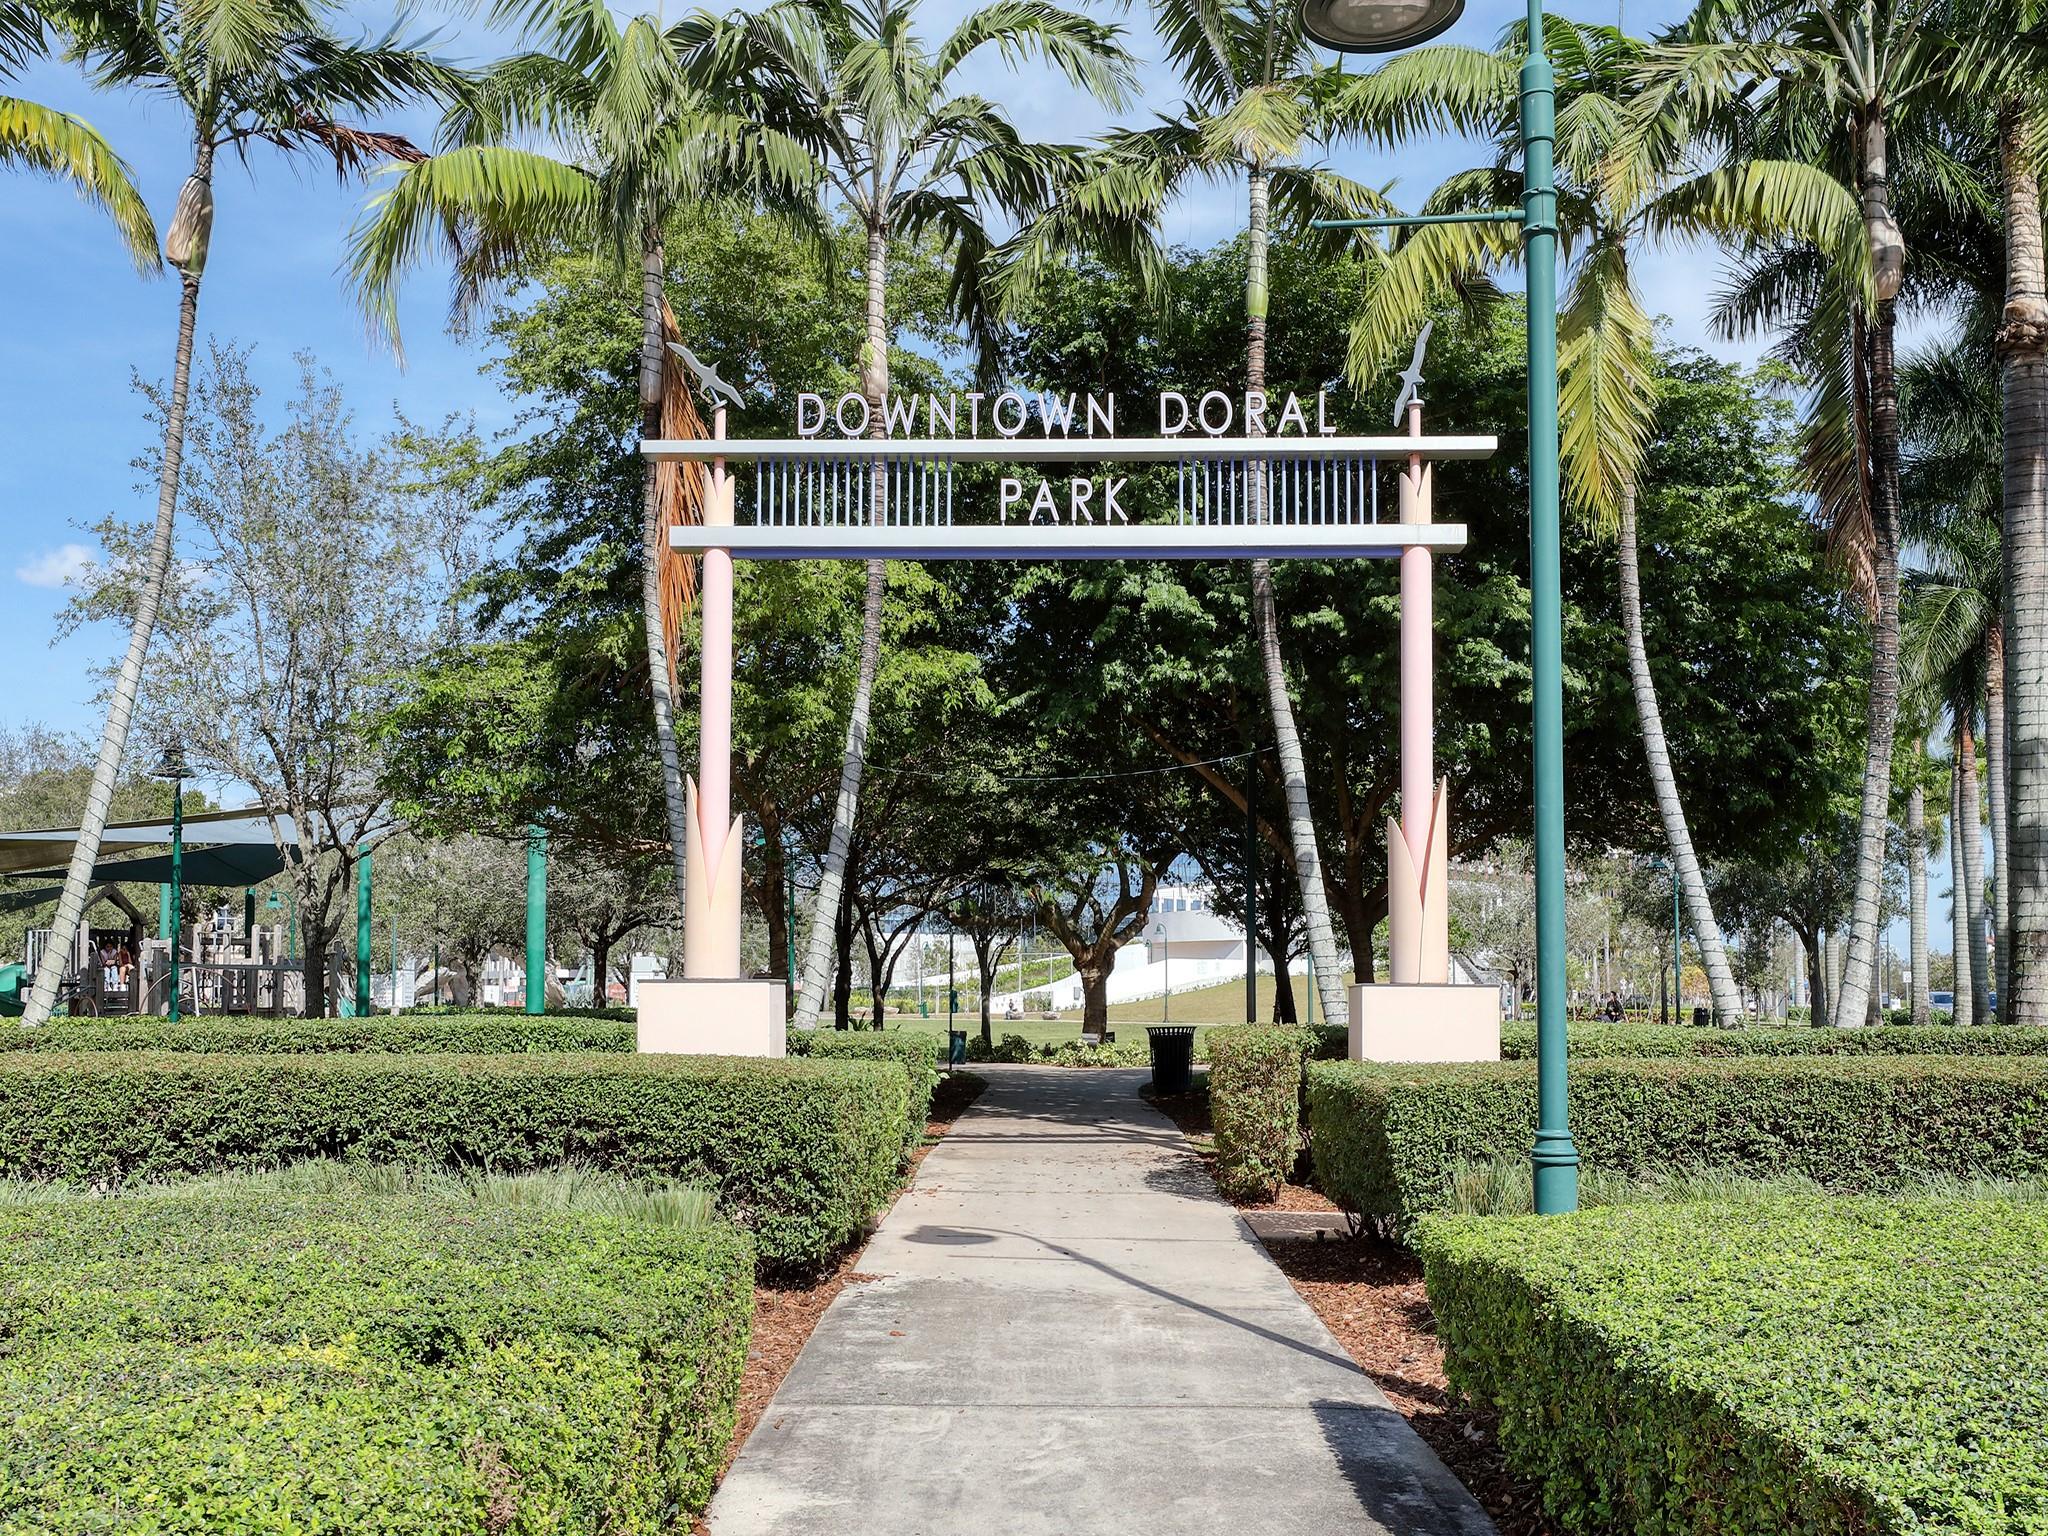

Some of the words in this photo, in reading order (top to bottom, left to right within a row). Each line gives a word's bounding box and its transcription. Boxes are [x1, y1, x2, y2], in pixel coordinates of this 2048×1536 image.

[797, 392, 1116, 436] DOWNTOWN
[1160, 390, 1337, 435] DORAL
[1000, 478, 1129, 522] PARK
